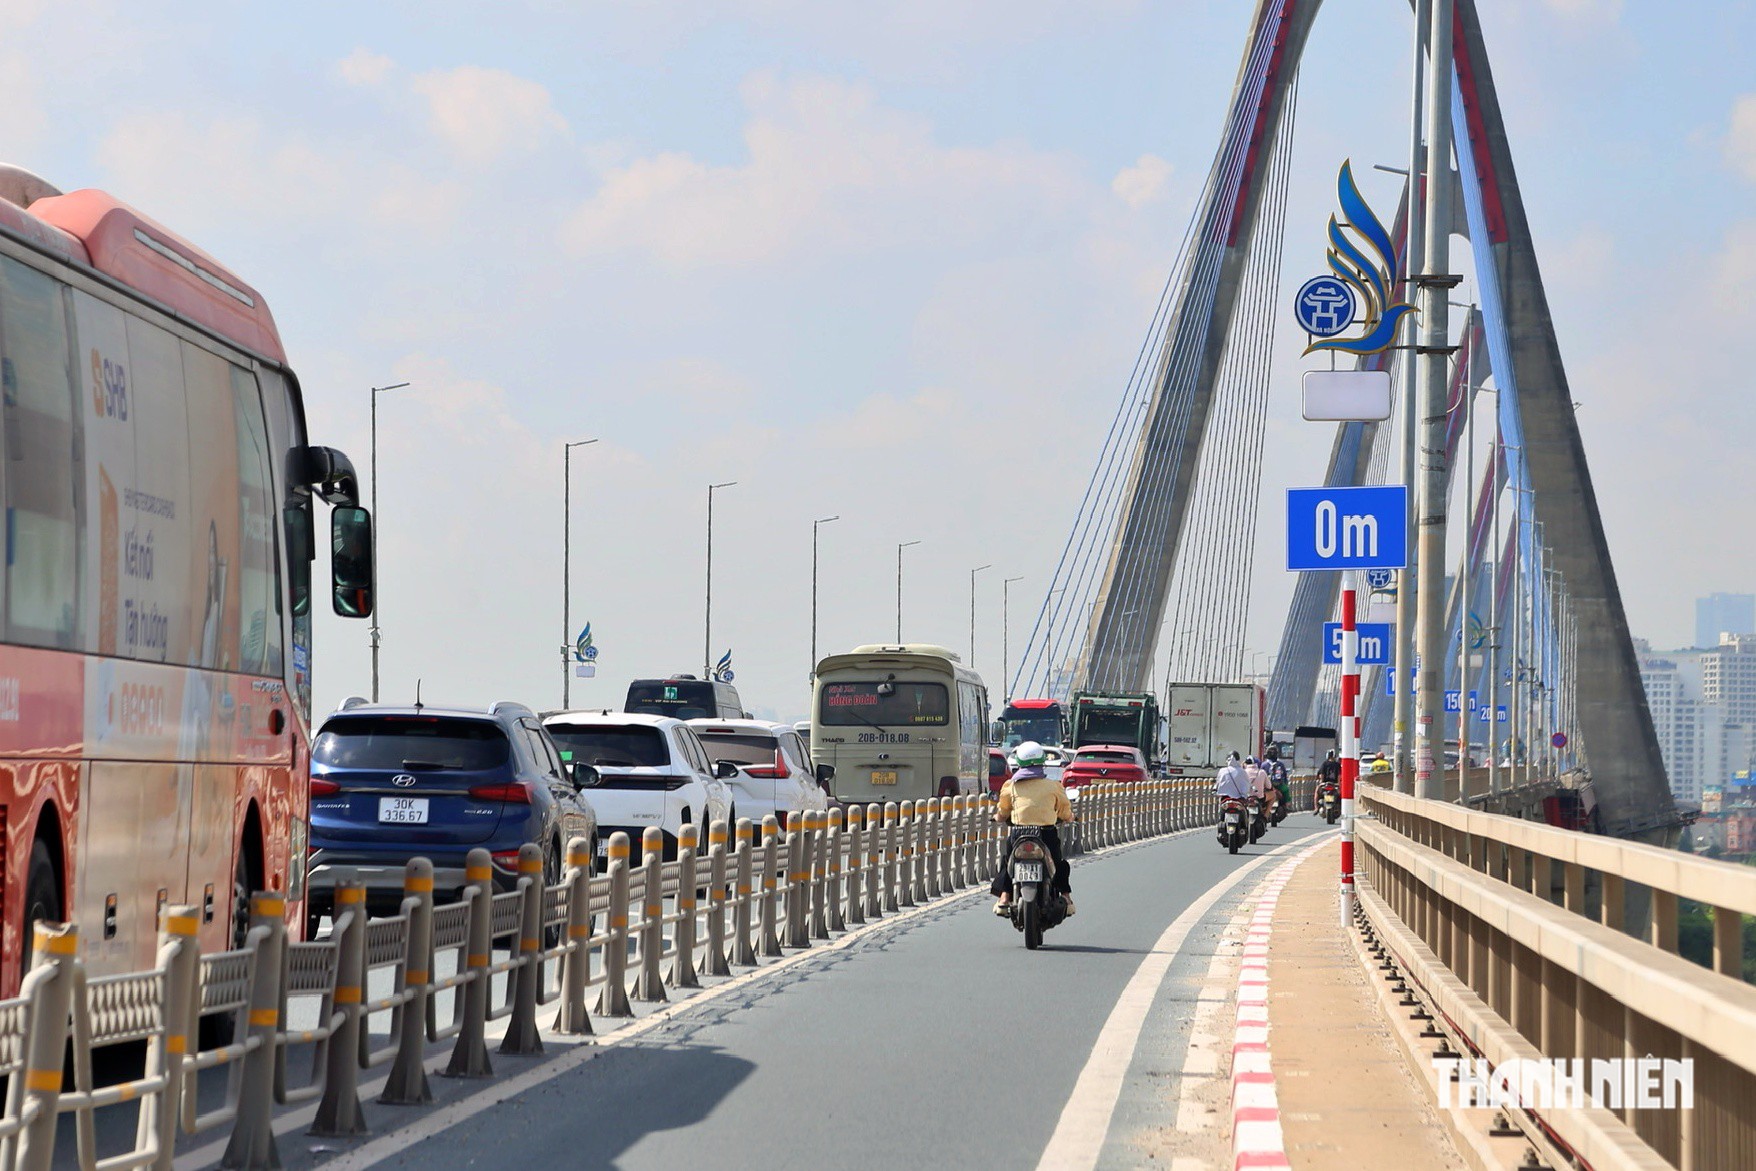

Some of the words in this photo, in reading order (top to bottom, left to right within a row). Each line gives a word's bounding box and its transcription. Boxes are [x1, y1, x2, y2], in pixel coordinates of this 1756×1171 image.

[1315, 499, 1378, 559] 0m
[1174, 709, 1192, 717] J&T
[1480, 706, 1506, 722] 20m
[394, 799, 414, 810] 30K
[384, 810, 423, 822] 336.67
